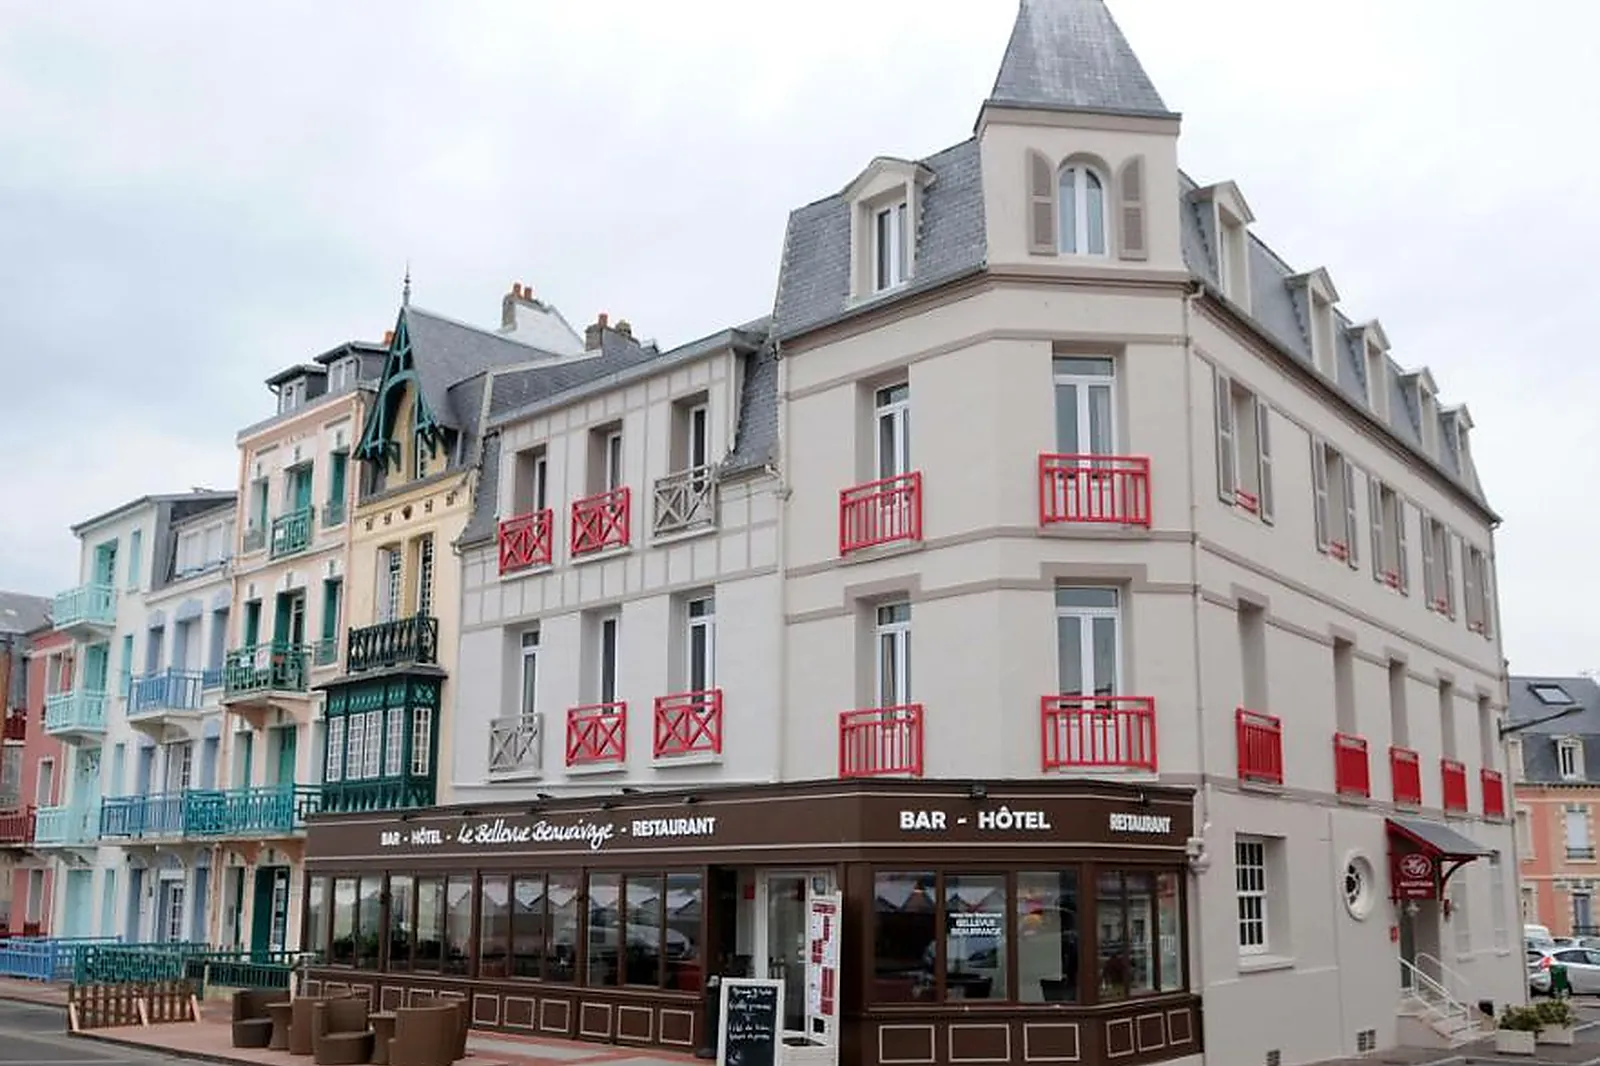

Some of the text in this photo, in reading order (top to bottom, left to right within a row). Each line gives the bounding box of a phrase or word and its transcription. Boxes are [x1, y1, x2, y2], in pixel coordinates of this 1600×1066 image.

[900, 811, 946, 829] BAR
[978, 806, 1051, 829] HÔTEL
[1109, 813, 1171, 833] RESTAURANT
[381, 831, 401, 846] BAR
[411, 827, 443, 845] HÔTEL
[457, 822, 474, 844] Le
[474, 818, 531, 844] Bellevue
[632, 817, 716, 837] RESTAURANT
